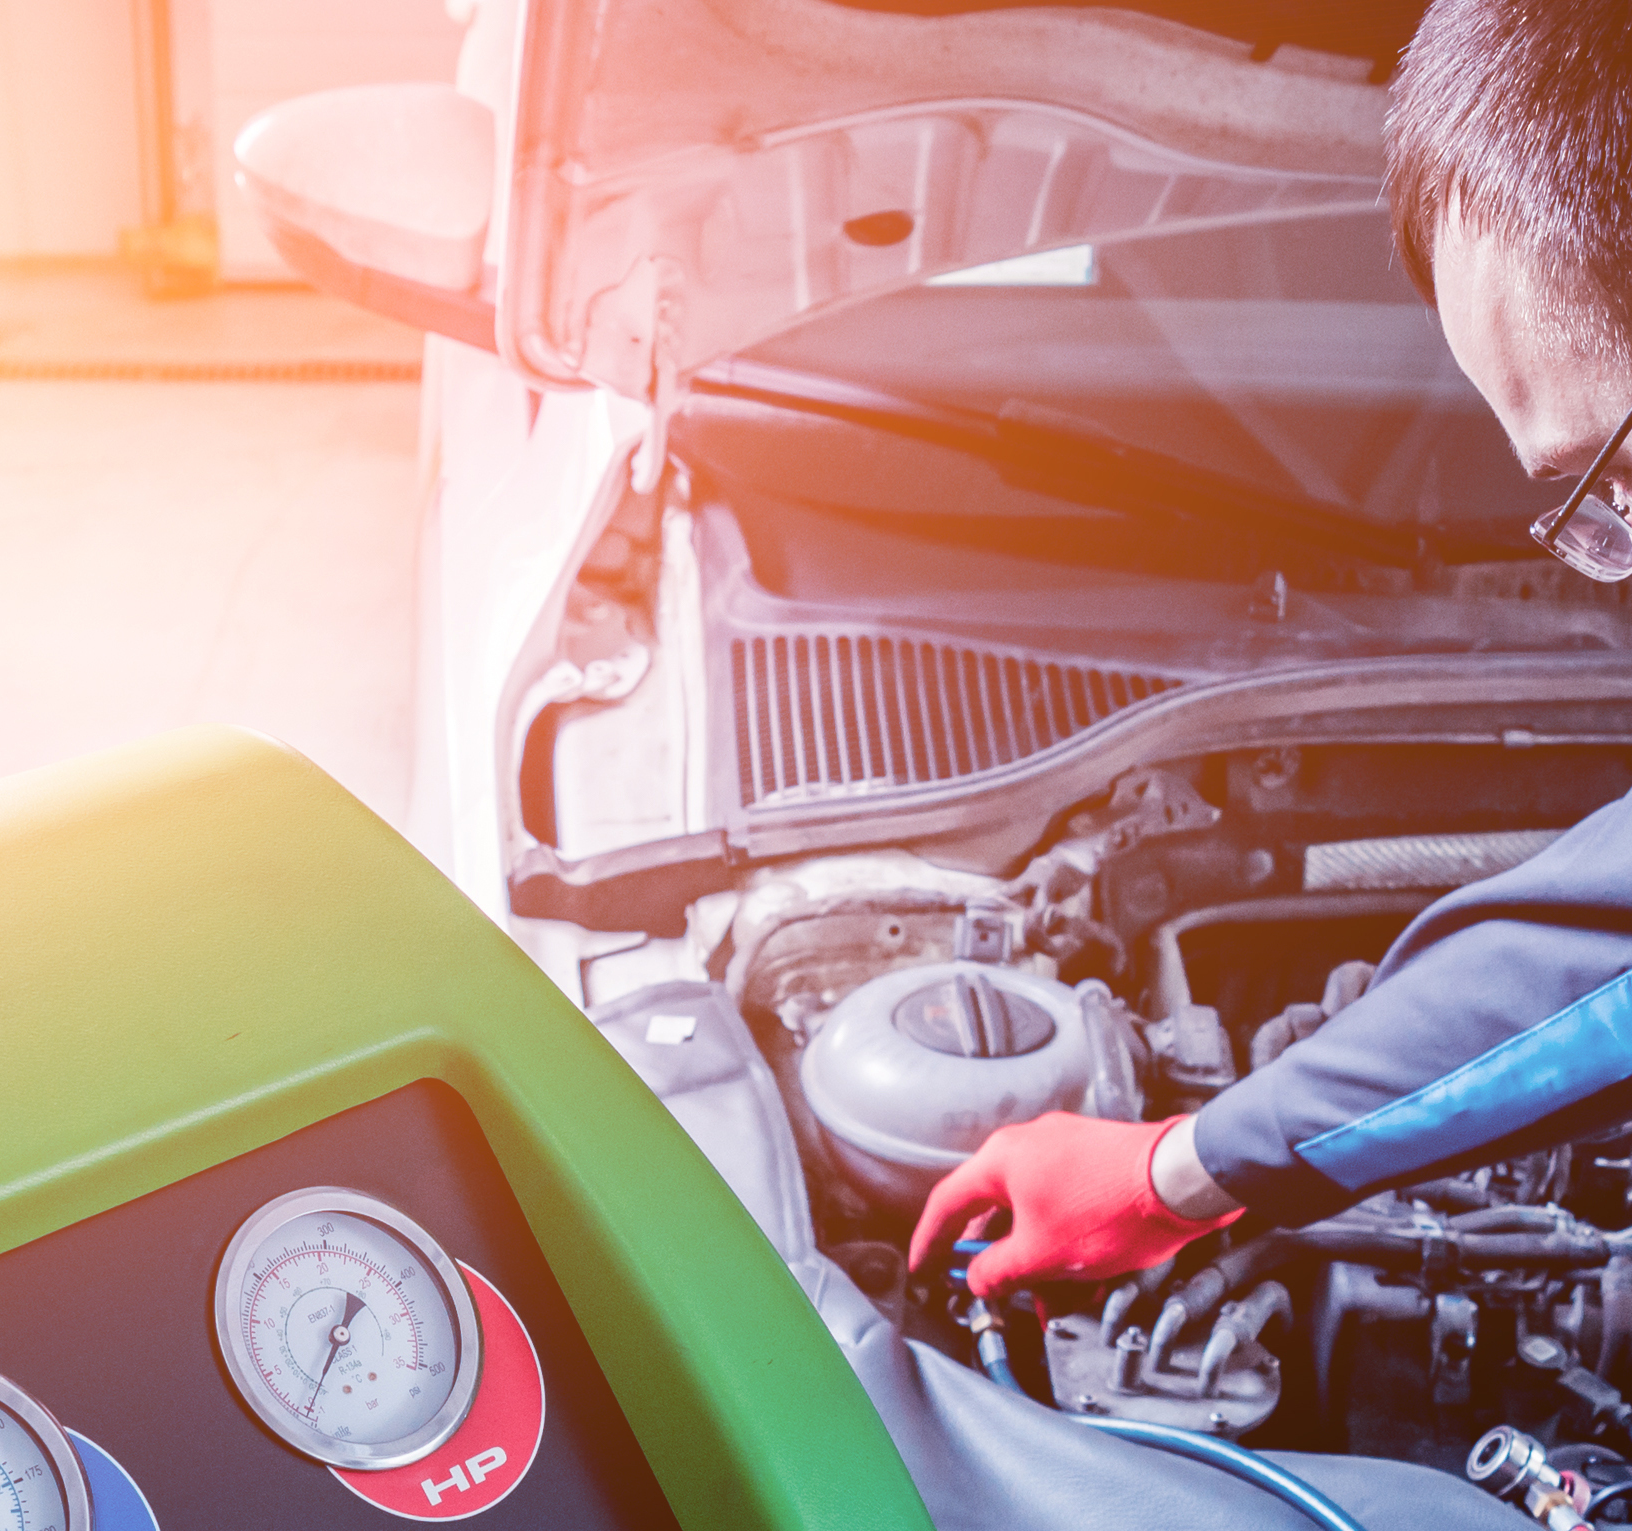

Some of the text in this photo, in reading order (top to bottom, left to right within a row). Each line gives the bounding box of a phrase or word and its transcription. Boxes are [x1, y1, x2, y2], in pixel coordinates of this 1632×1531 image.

[317, 1222, 335, 1237] 300
[316, 1262, 329, 1275] 20
[400, 1266, 416, 1280] 400
[279, 1277, 291, 1290] 15
[359, 1276, 372, 1290] 25
[307, 1304, 336, 1324] EN837-1
[389, 1313, 402, 1326] 30
[263, 1317, 276, 1330] 10
[352, 1344, 358, 1353] 1
[338, 1359, 363, 1376] R-134a
[392, 1355, 406, 1369] 35
[428, 1361, 446, 1377] 500
[273, 1364, 282, 1376] 5
[408, 1383, 421, 1398] psi
[365, 1398, 379, 1411] bar
[24, 1464, 43, 1480] 175
[421, 1446, 508, 1506] HP
